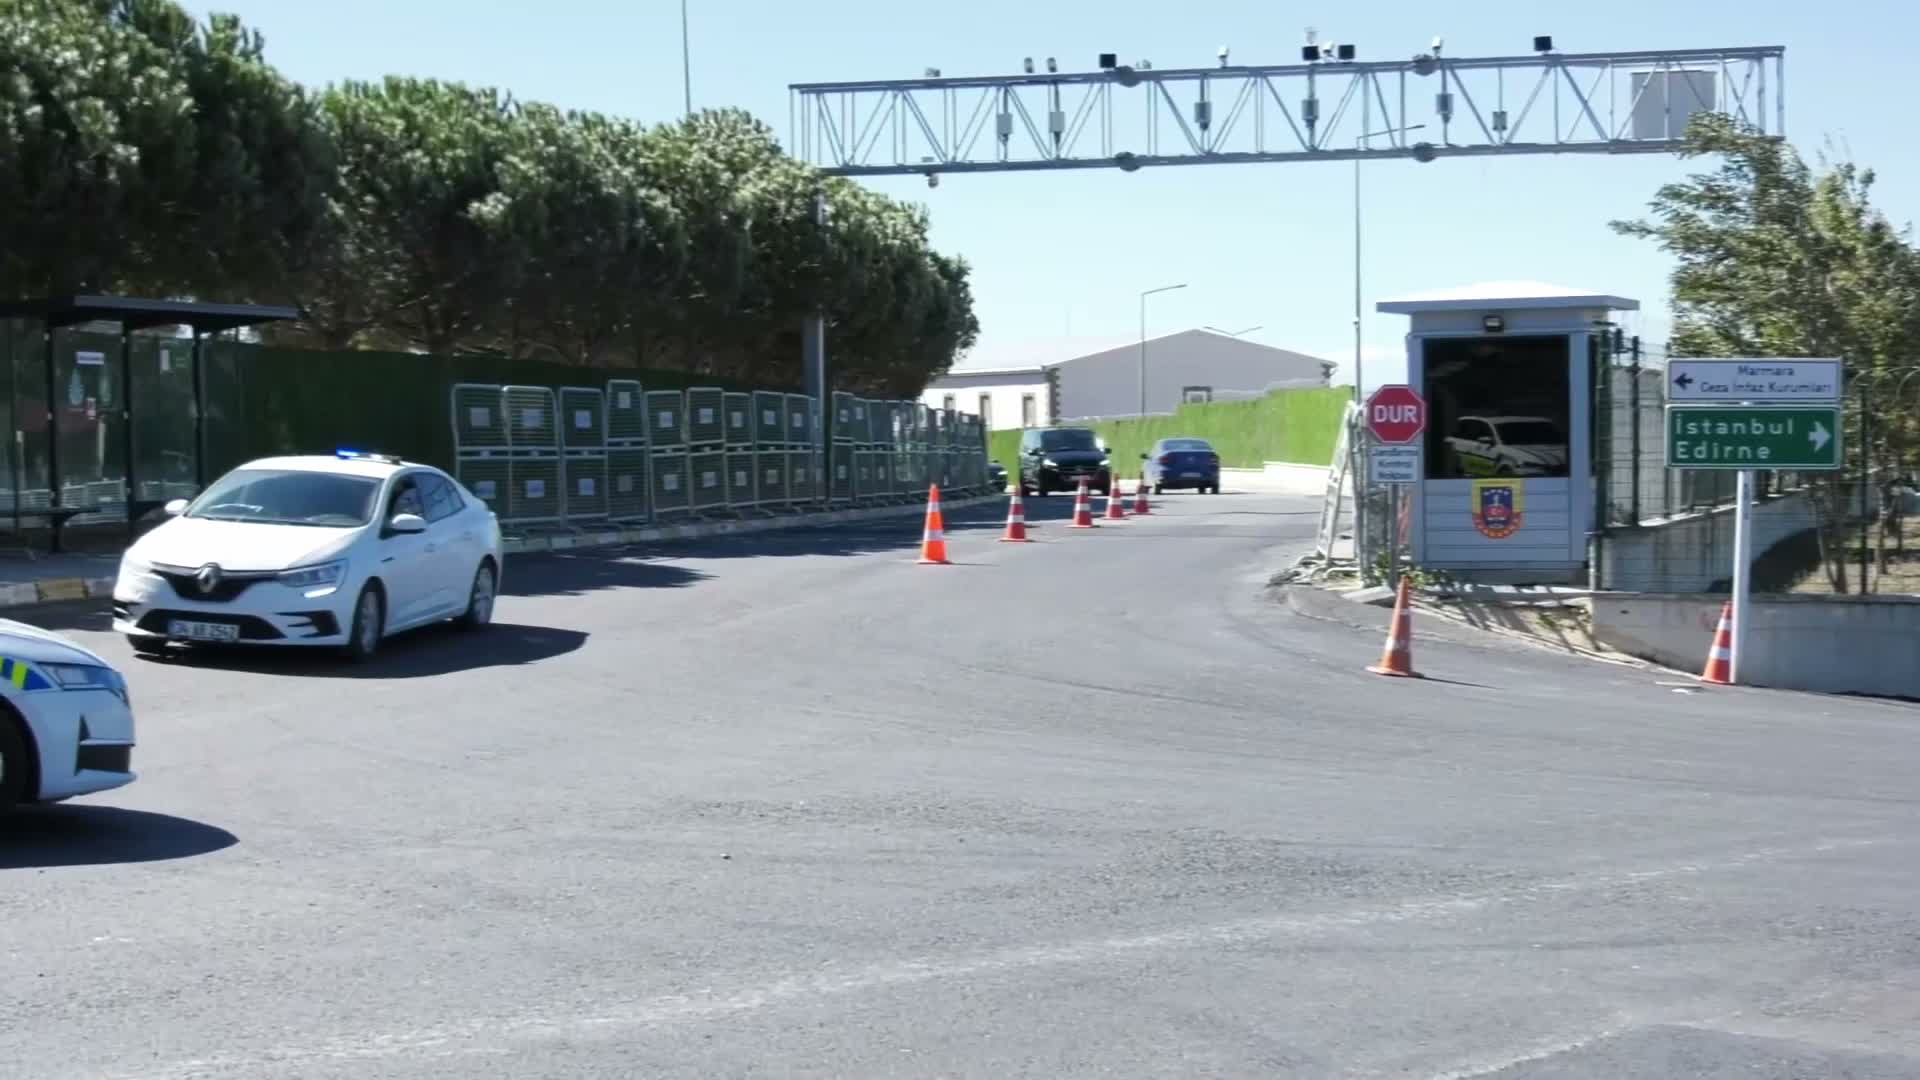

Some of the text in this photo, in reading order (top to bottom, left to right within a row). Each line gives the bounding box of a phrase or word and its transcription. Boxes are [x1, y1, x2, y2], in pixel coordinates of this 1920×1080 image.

[1737, 364, 1795, 377] Marmara
[1700, 381, 1729, 393] Ceza
[1374, 405, 1417, 423] DUR
[1675, 413, 1793, 435] İstanbul
[1676, 440, 1771, 460] Edirne
